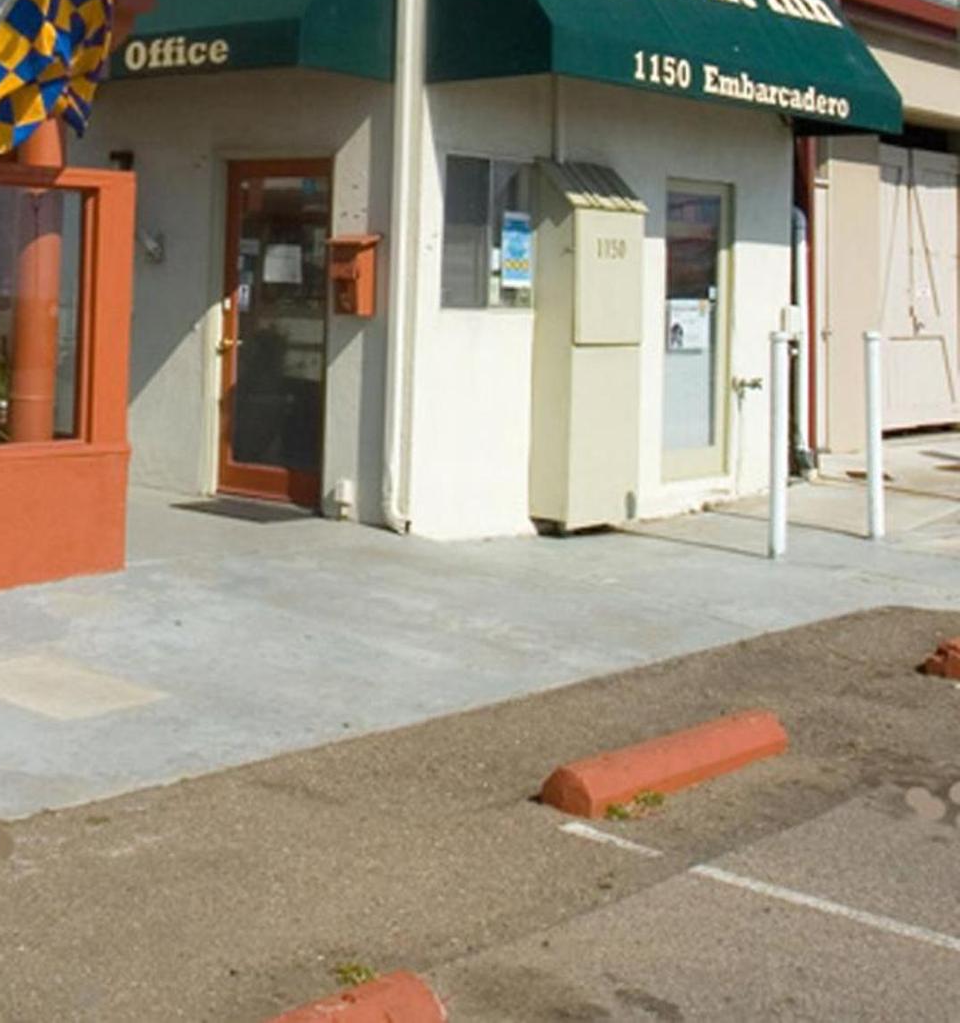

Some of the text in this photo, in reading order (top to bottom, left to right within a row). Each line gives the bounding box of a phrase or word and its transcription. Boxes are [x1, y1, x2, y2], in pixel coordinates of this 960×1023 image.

[124, 35, 230, 71] Office
[634, 50, 850, 119] 1150 Embarcadero
